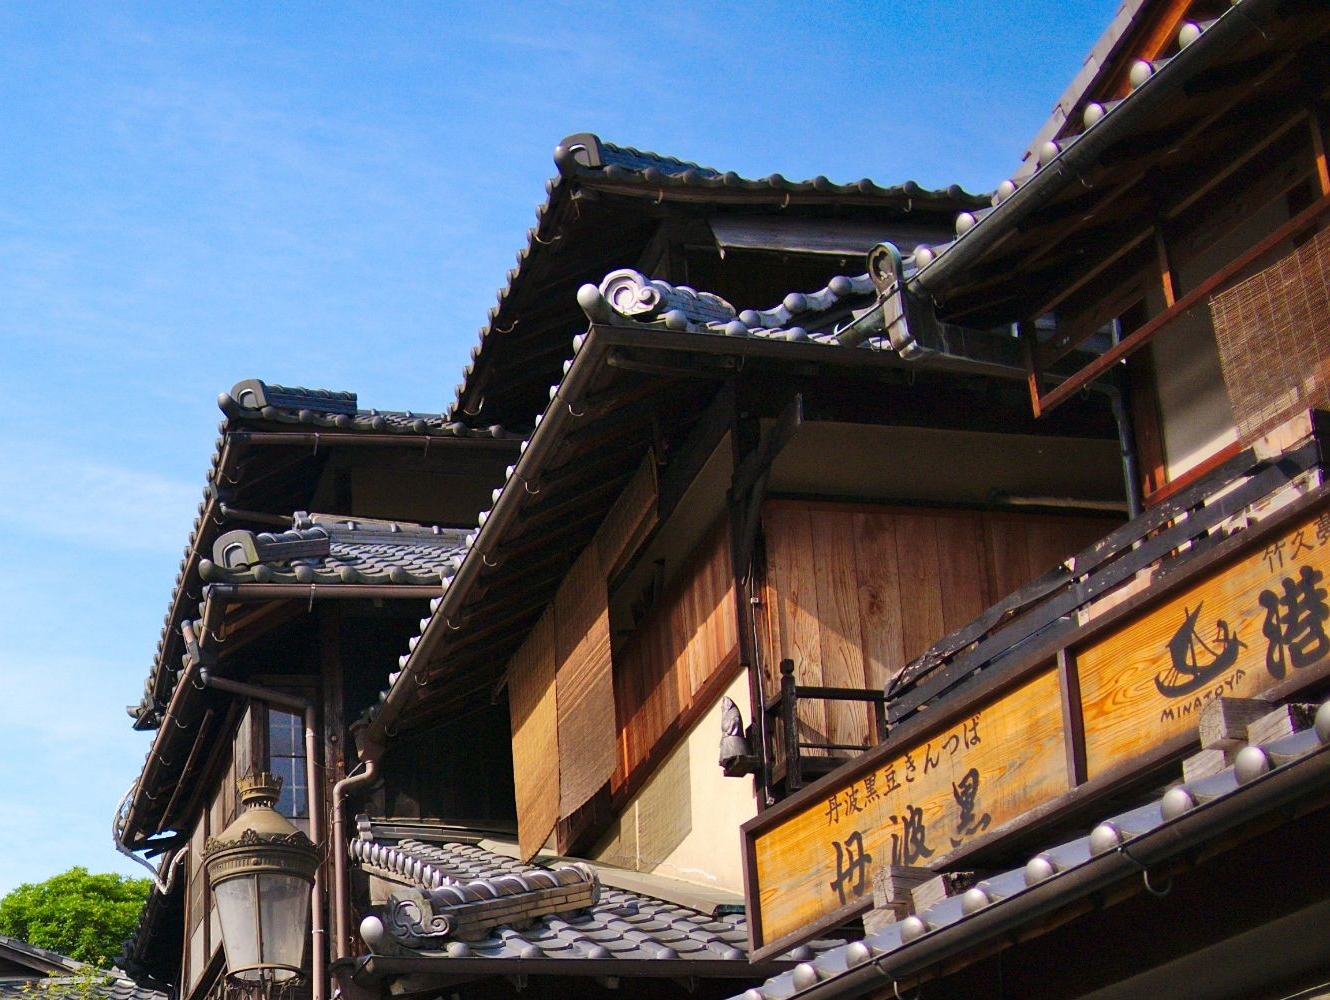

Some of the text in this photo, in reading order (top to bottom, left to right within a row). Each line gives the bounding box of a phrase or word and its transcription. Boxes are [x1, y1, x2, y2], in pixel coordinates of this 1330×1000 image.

[1160, 667, 1247, 723] MINATOYA
[825, 711, 983, 826] 丹波黒豆きんつば
[831, 767, 992, 904] 丹波黒
